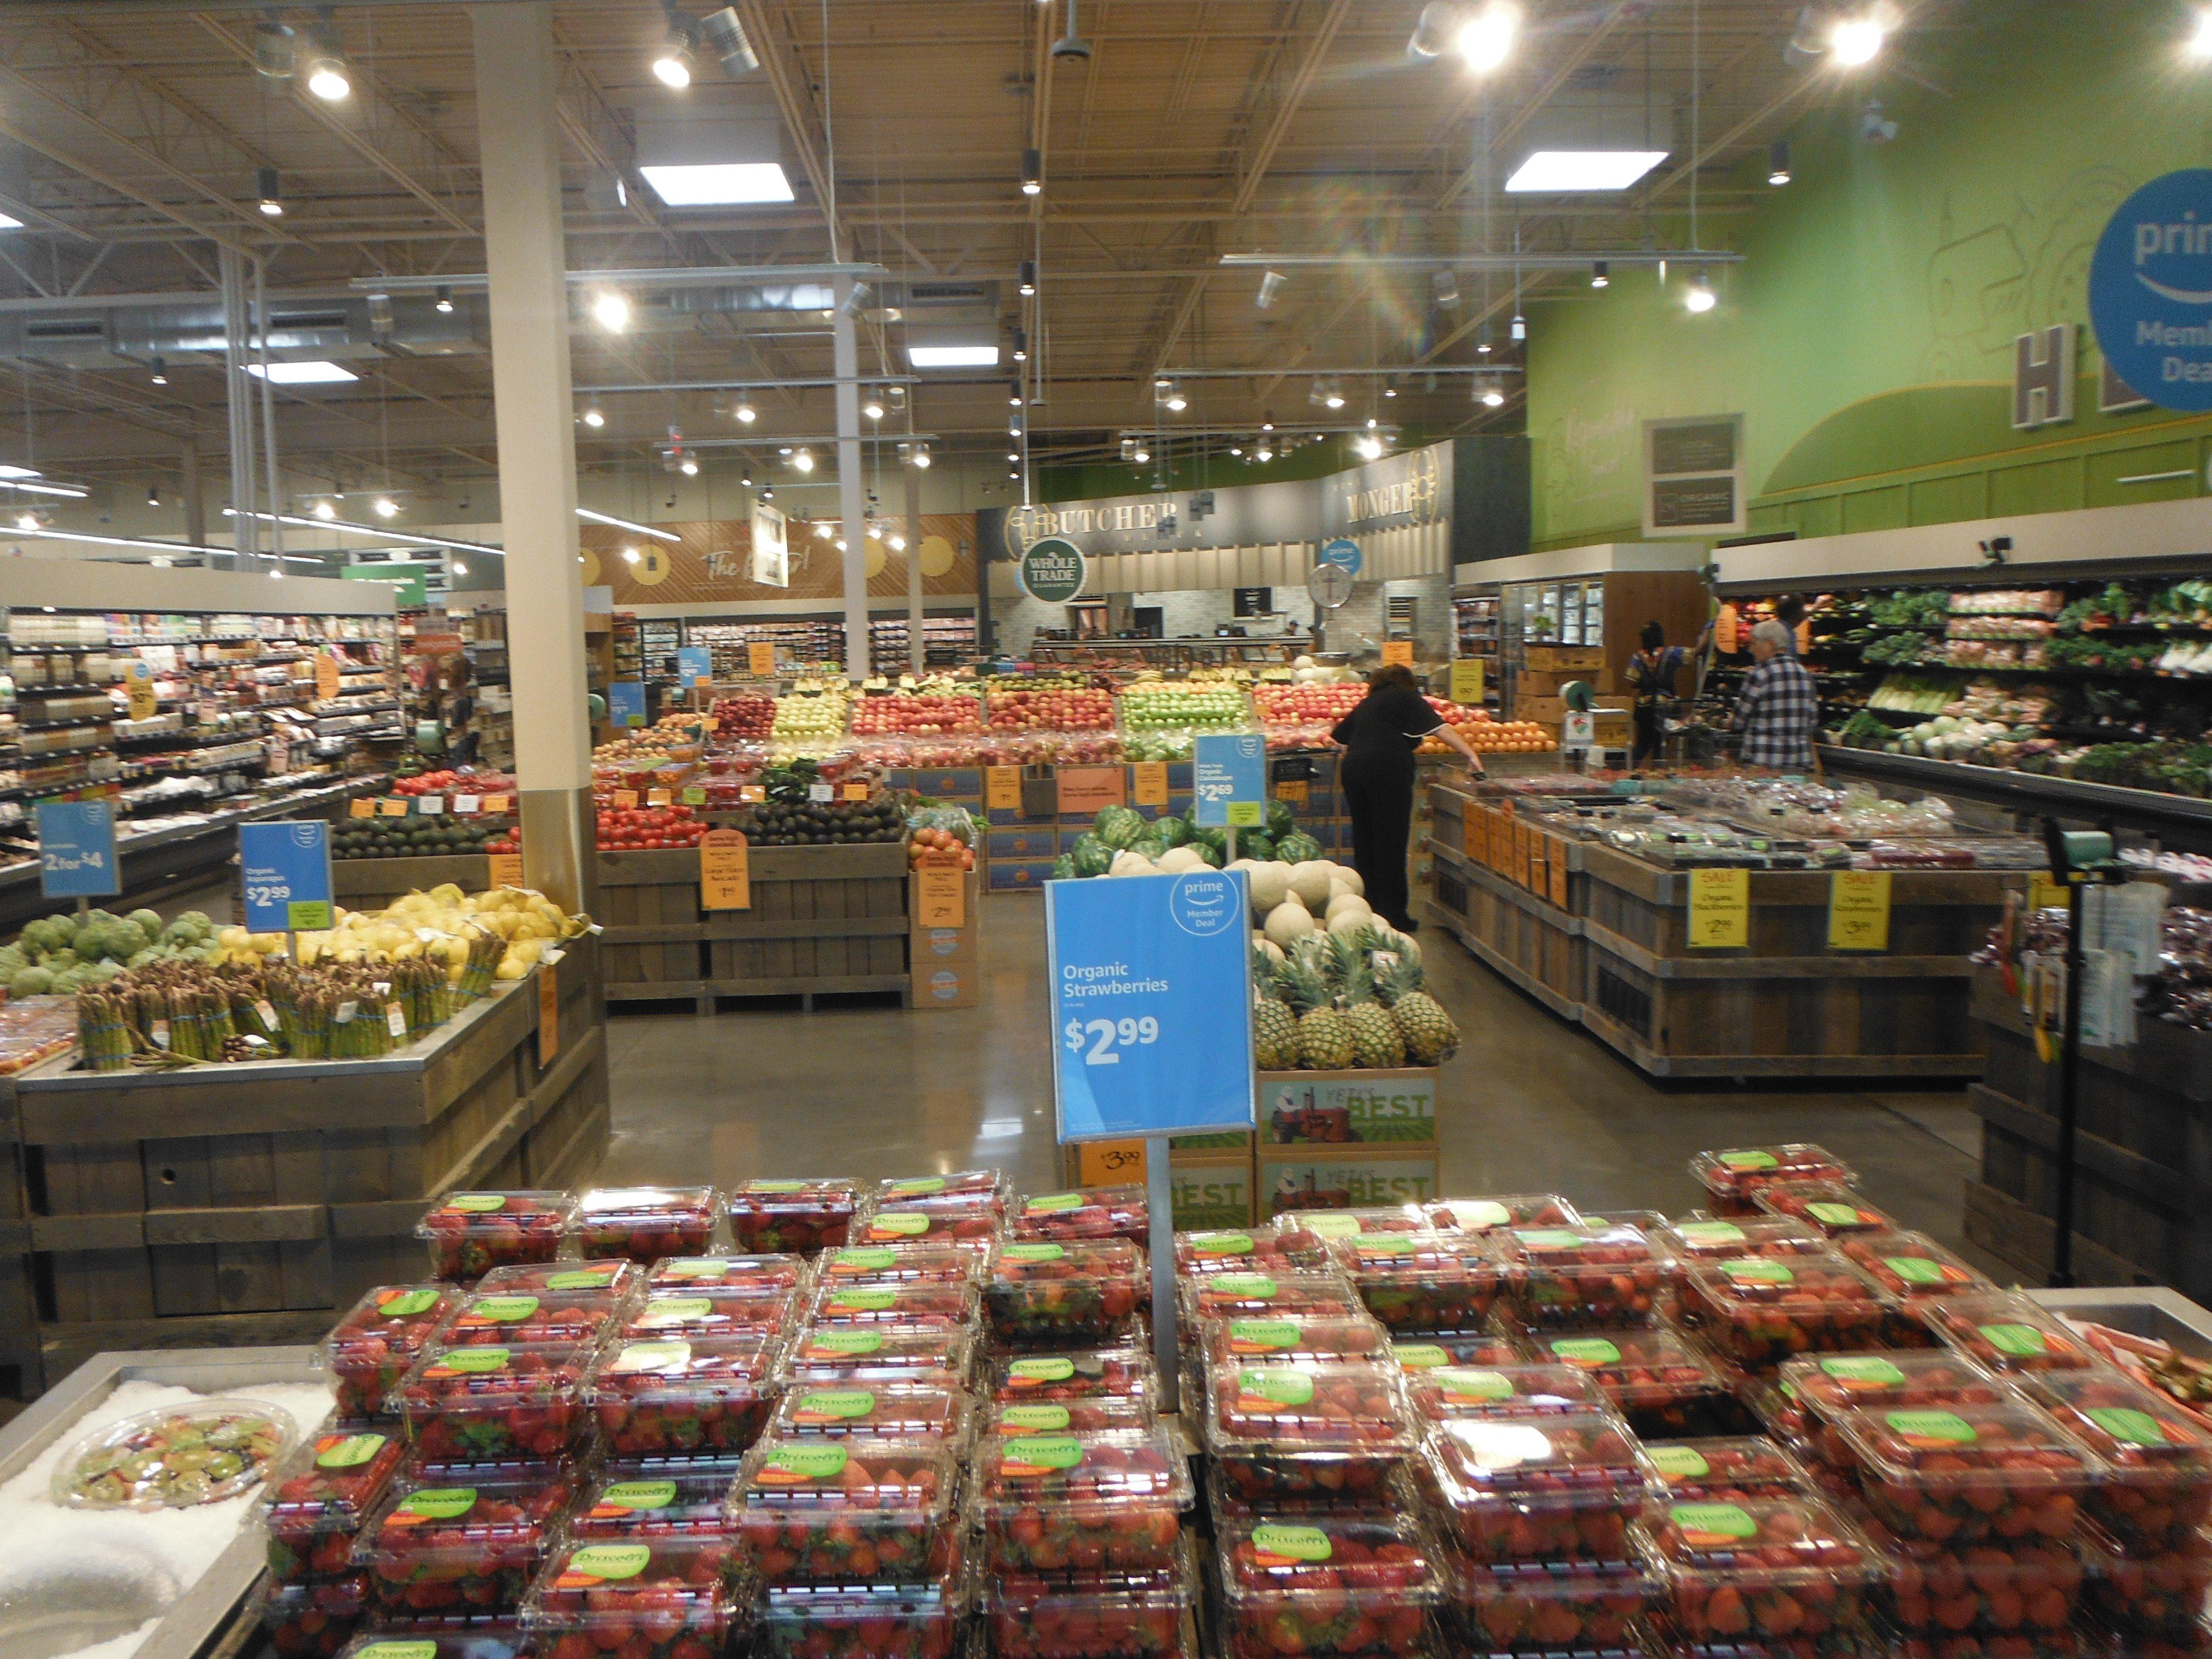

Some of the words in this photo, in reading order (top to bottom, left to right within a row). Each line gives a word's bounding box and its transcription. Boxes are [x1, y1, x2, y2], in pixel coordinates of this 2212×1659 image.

[1028, 557, 1078, 568] WHOLE
[1030, 569, 1076, 582] TRADE
[44, 854, 58, 870] 2
[1700, 870, 1736, 883] SALE
[1844, 874, 1876, 884] SALE
[1185, 880, 1224, 896] prime
[1187, 909, 1224, 919] Member
[1195, 918, 1216, 927] Deal
[1063, 962, 1129, 982] Organic
[1063, 978, 1169, 998] Strawberries
[1347, 1094, 1430, 1118] BEST
[1347, 1177, 1430, 1201] BEST
